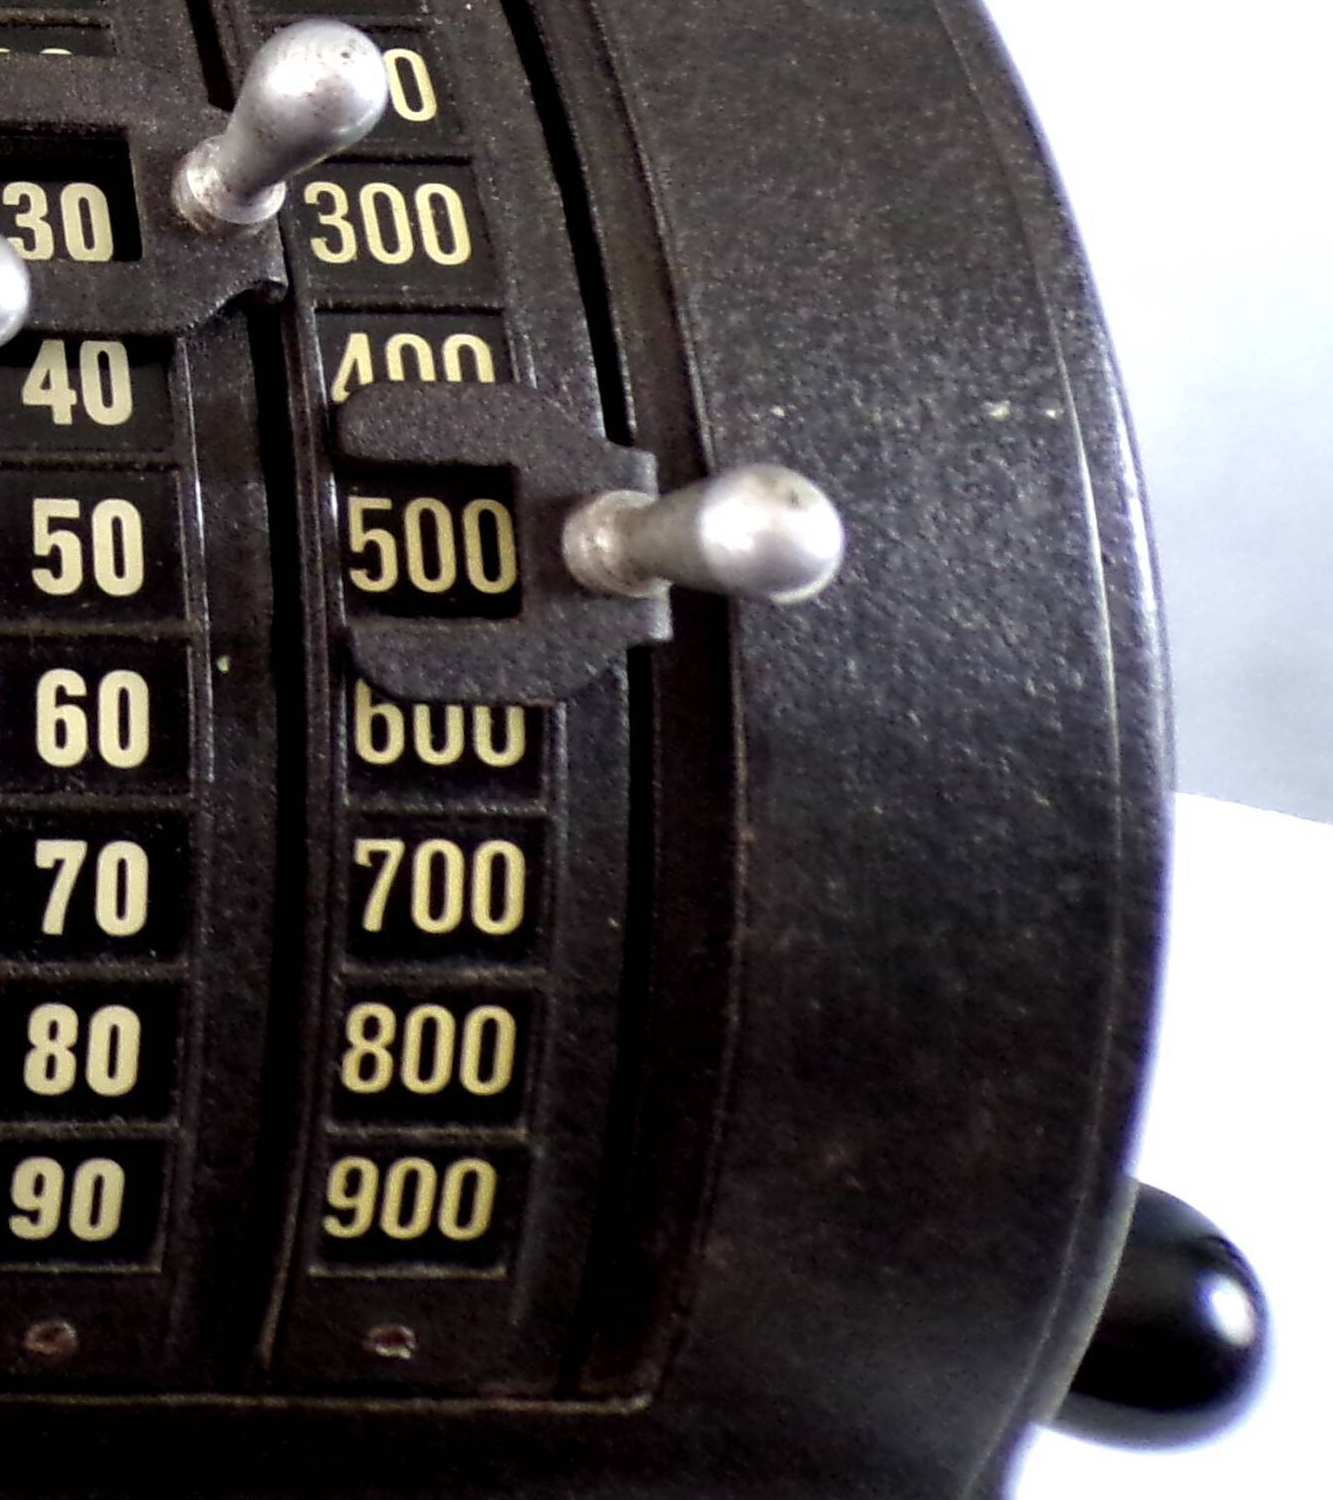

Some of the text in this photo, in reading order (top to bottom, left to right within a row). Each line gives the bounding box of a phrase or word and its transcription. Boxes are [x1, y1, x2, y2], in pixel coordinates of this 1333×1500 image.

[1, 181, 115, 263] 30
[305, 180, 471, 266] 300
[21, 338, 134, 426] 40
[31, 498, 146, 597] 50
[348, 497, 516, 595] 500
[35, 667, 151, 767] 60
[34, 839, 150, 936] 70
[354, 839, 527, 935] 700
[23, 1003, 142, 1097] 80
[340, 1004, 517, 1097] 800
[8, 1157, 126, 1242] 90
[323, 1157, 499, 1242] 900
